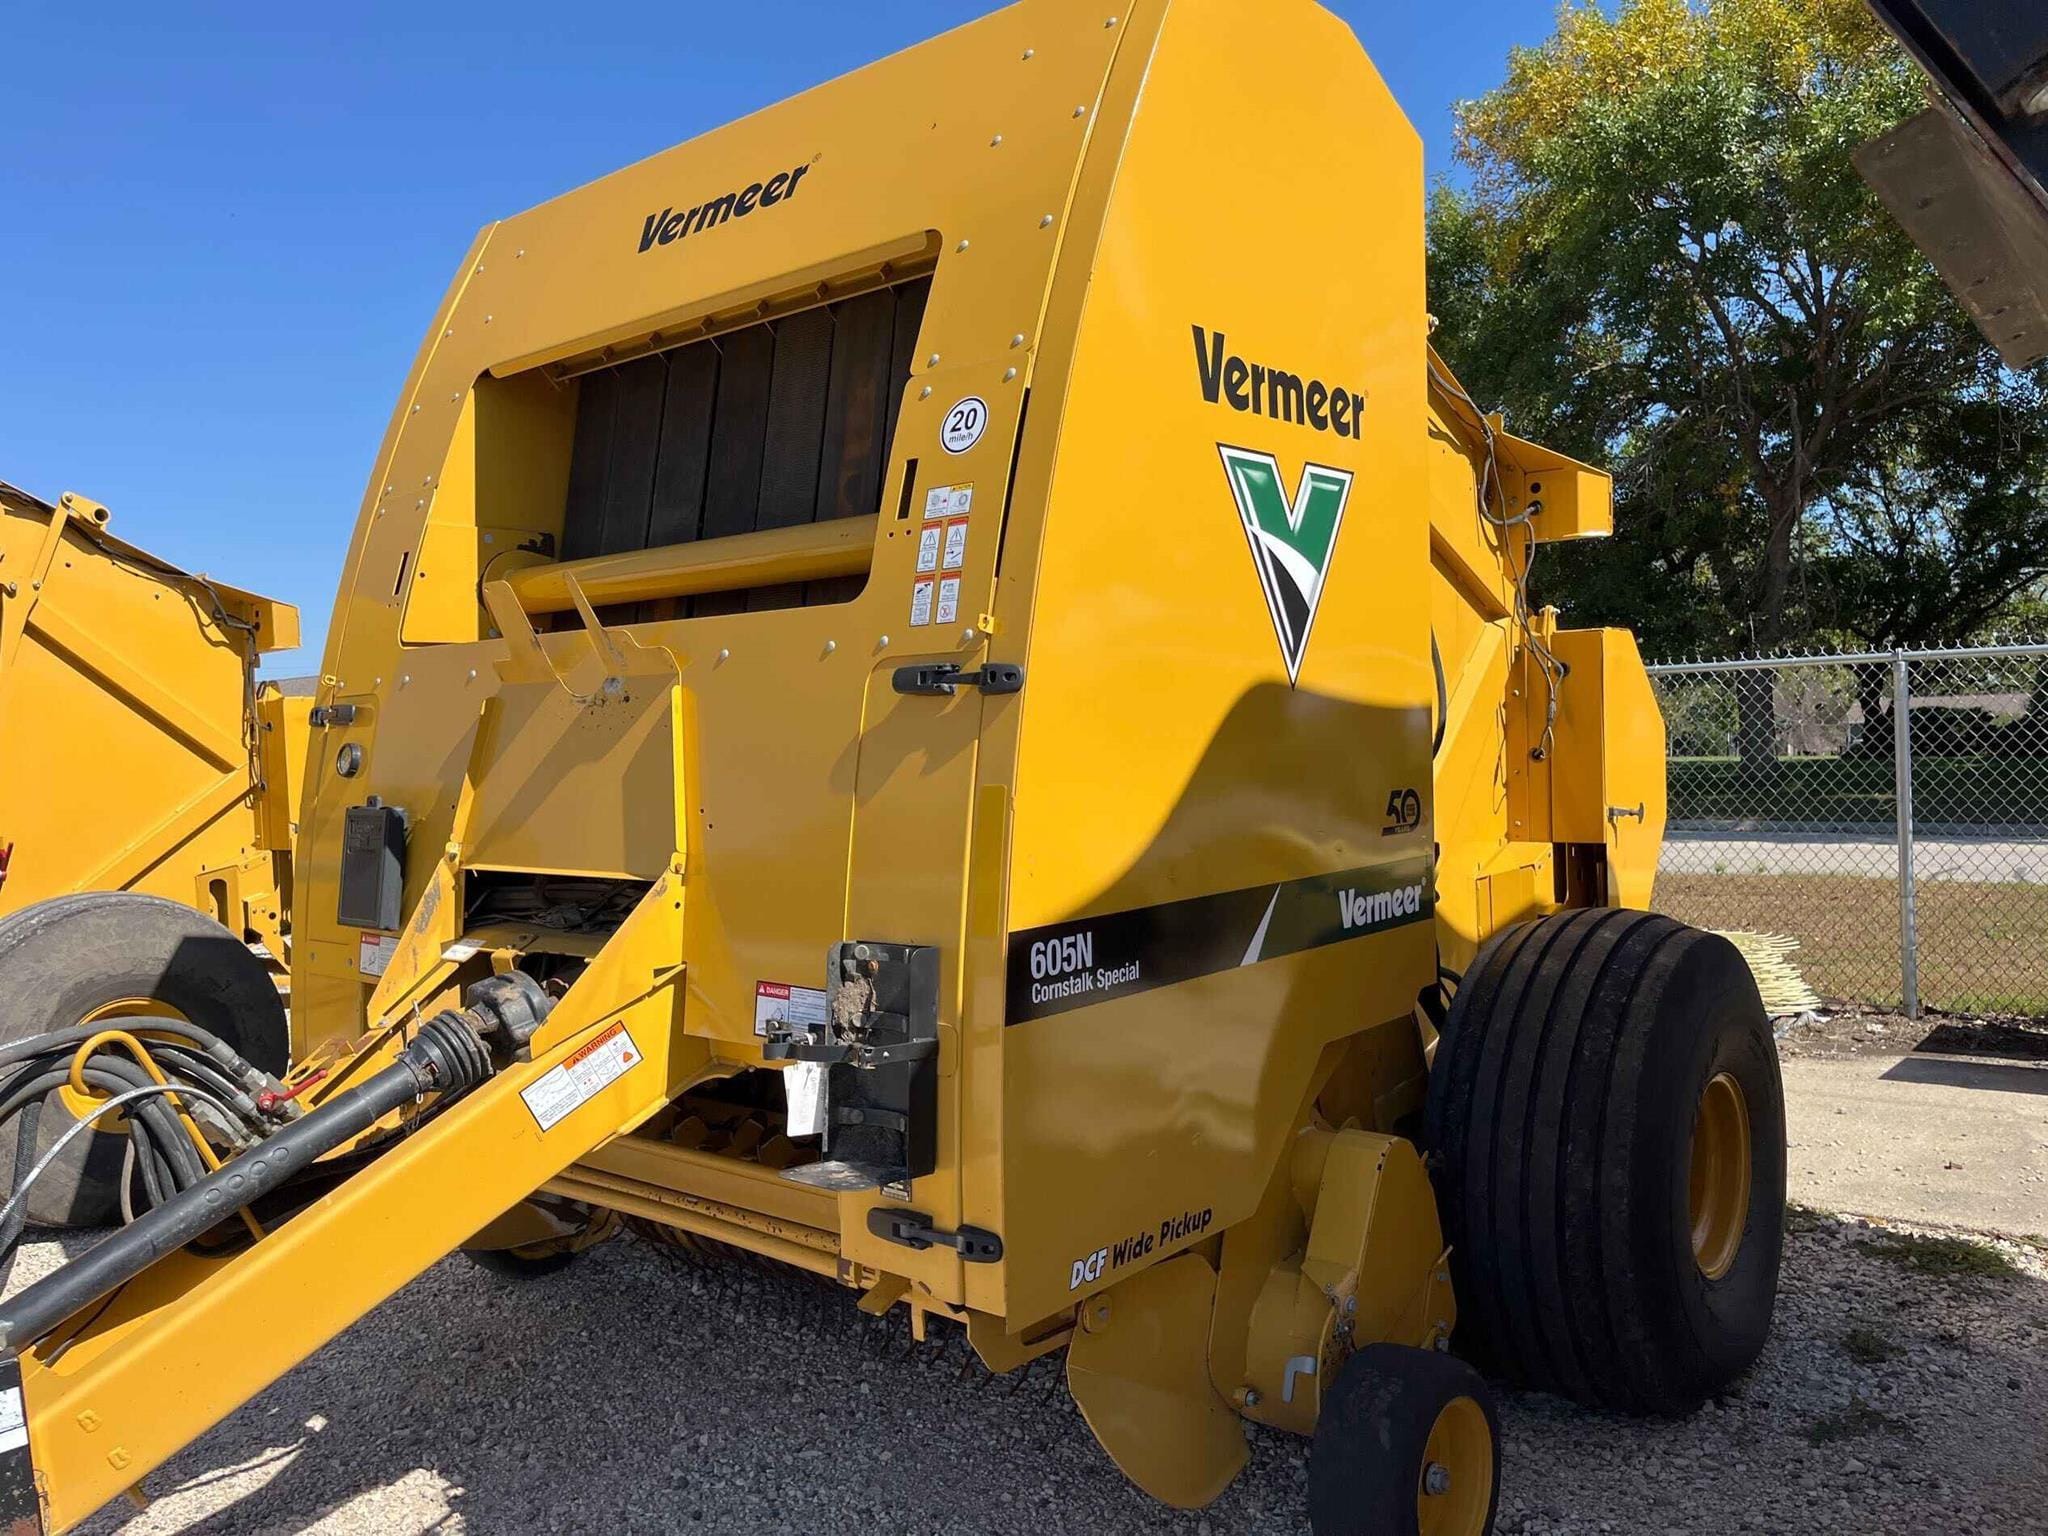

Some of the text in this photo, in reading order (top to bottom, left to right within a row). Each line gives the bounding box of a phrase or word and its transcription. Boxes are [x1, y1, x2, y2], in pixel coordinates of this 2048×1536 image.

[638, 163, 811, 254] Vermeer
[1191, 324, 1365, 441] Vermeer
[950, 407, 978, 432] 20
[1338, 884, 1423, 929] Vermeer
[1030, 931, 1093, 980] 605N
[766, 986, 789, 997] DANGER
[1031, 960, 1140, 1004] Cornstalk Special
[577, 1028, 617, 1058] WARNING
[1069, 1207, 1212, 1291] DCF Wide Pickup
